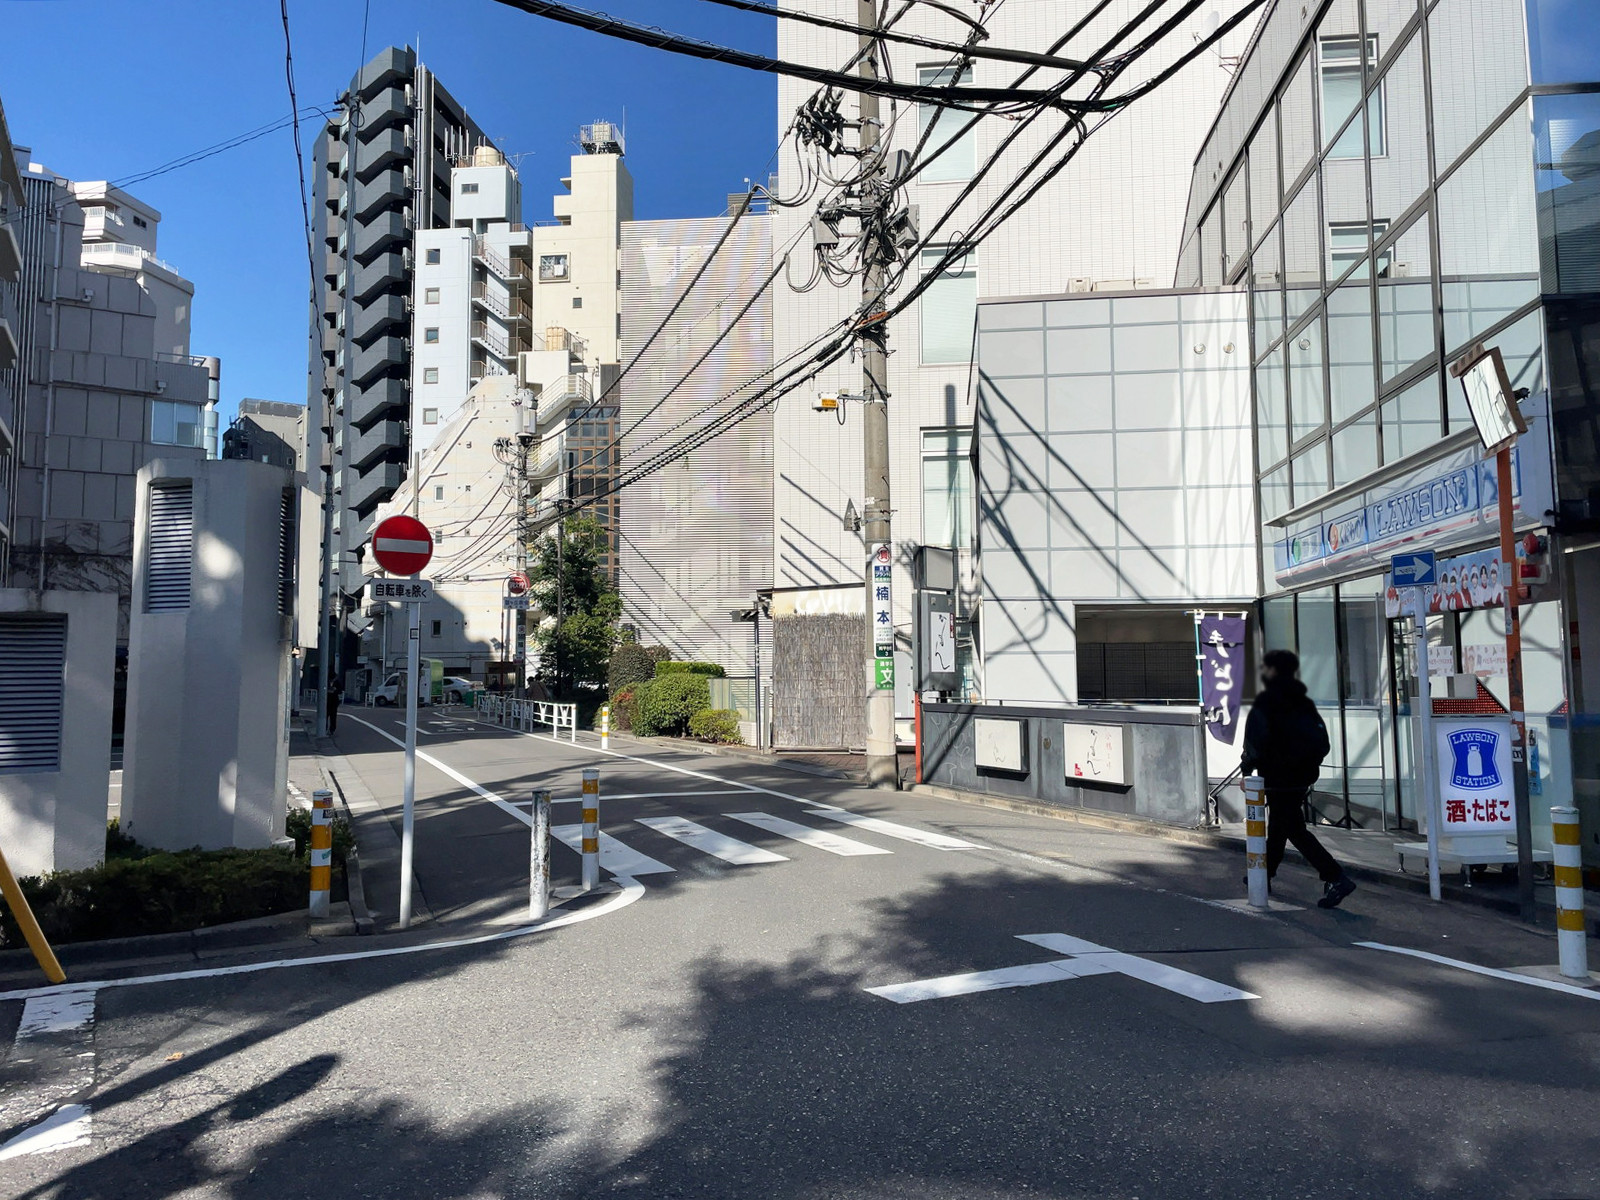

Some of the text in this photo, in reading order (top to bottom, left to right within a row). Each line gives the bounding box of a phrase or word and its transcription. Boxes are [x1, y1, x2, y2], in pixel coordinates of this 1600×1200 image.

[1378, 476, 1464, 536] LAWSON
[375, 584, 427, 599] 自転車を除く
[880, 668, 893, 684] 文
[1453, 733, 1495, 744] LAWSON
[1455, 775, 1497, 787] STATION
[1446, 799, 1511, 823] 酒・たばこ
